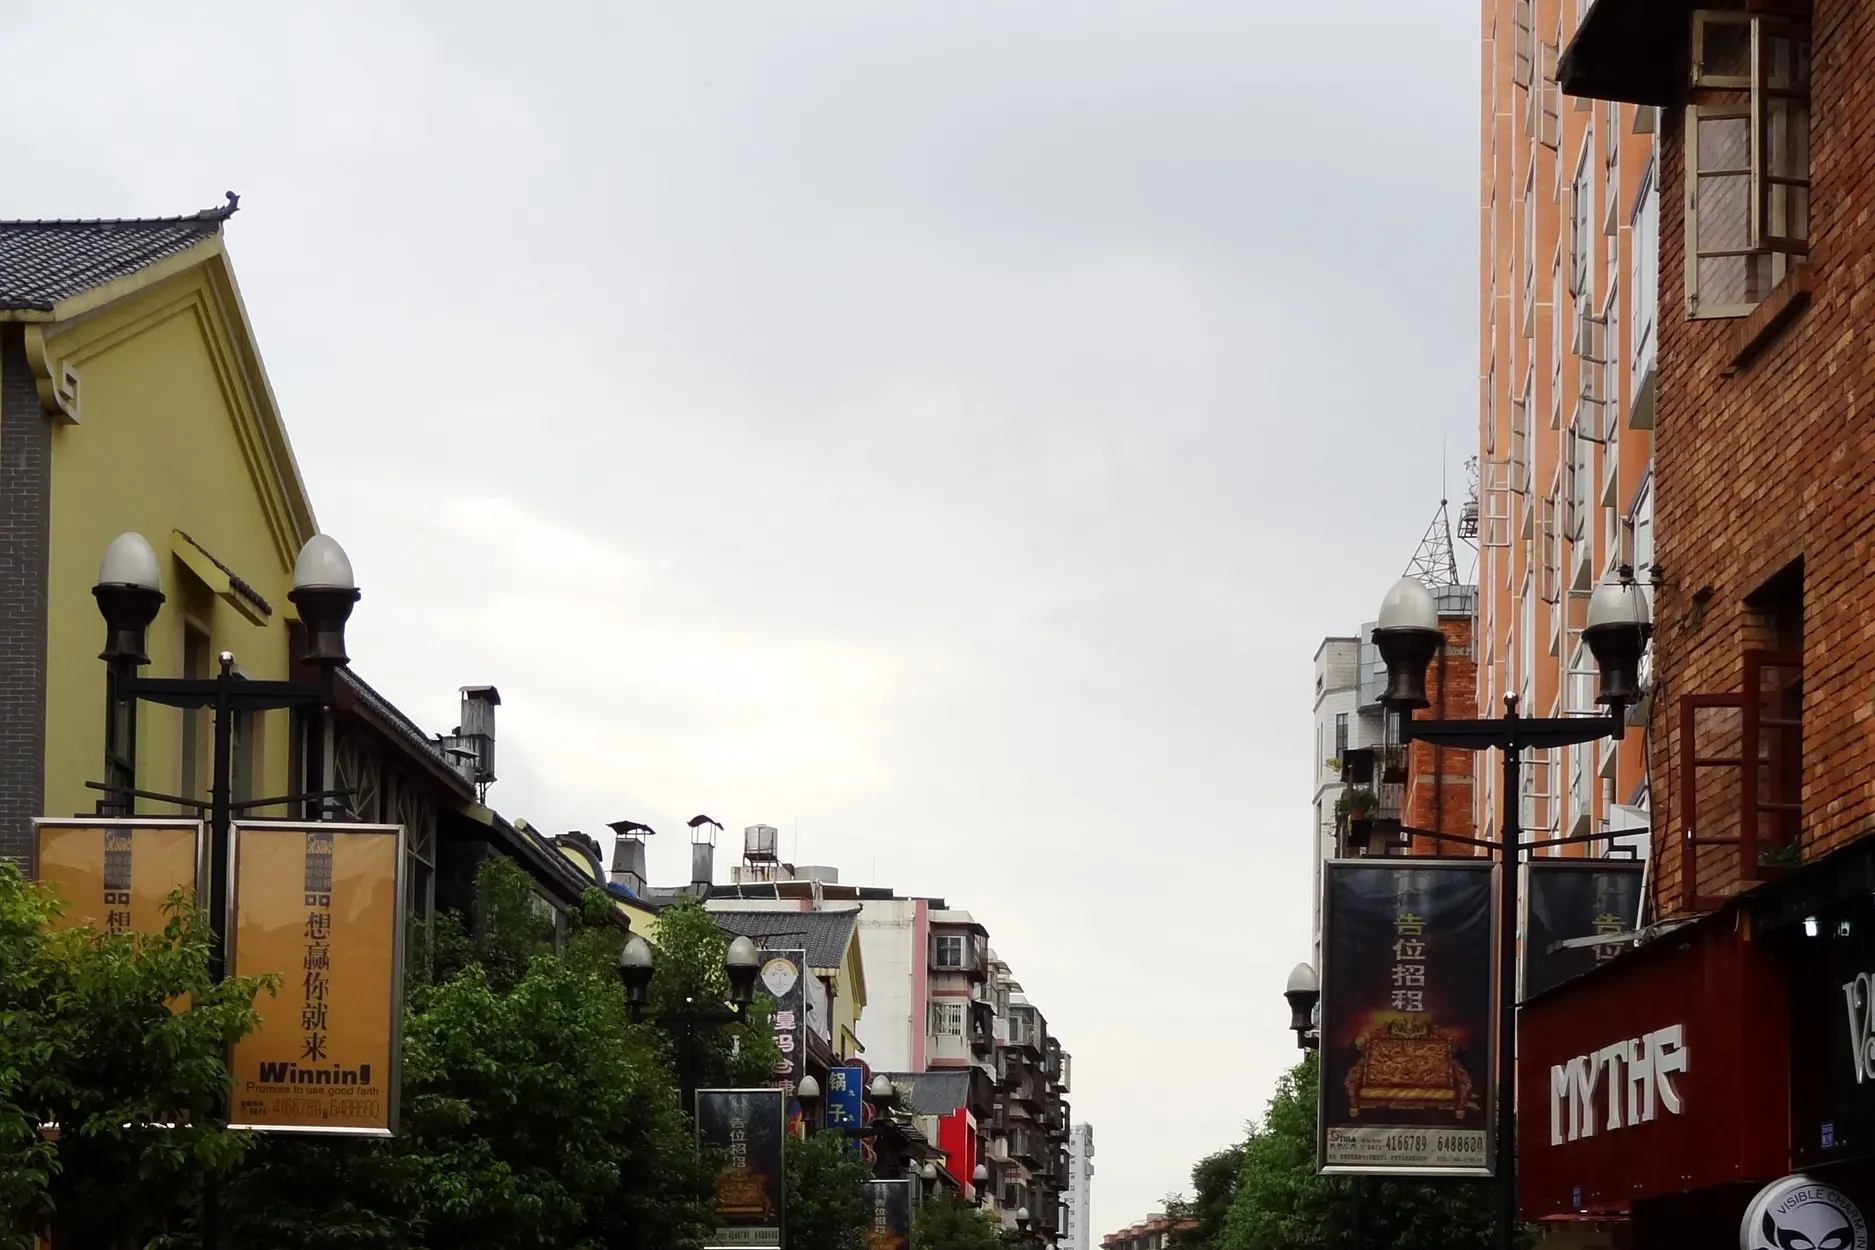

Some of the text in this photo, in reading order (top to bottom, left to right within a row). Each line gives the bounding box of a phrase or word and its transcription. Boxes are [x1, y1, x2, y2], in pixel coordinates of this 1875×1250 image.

[246, 1081, 379, 1097] Promise to use good faith
[1385, 1135, 1427, 1151] 4166789
[1777, 1189, 1825, 1215] VISIBLE
